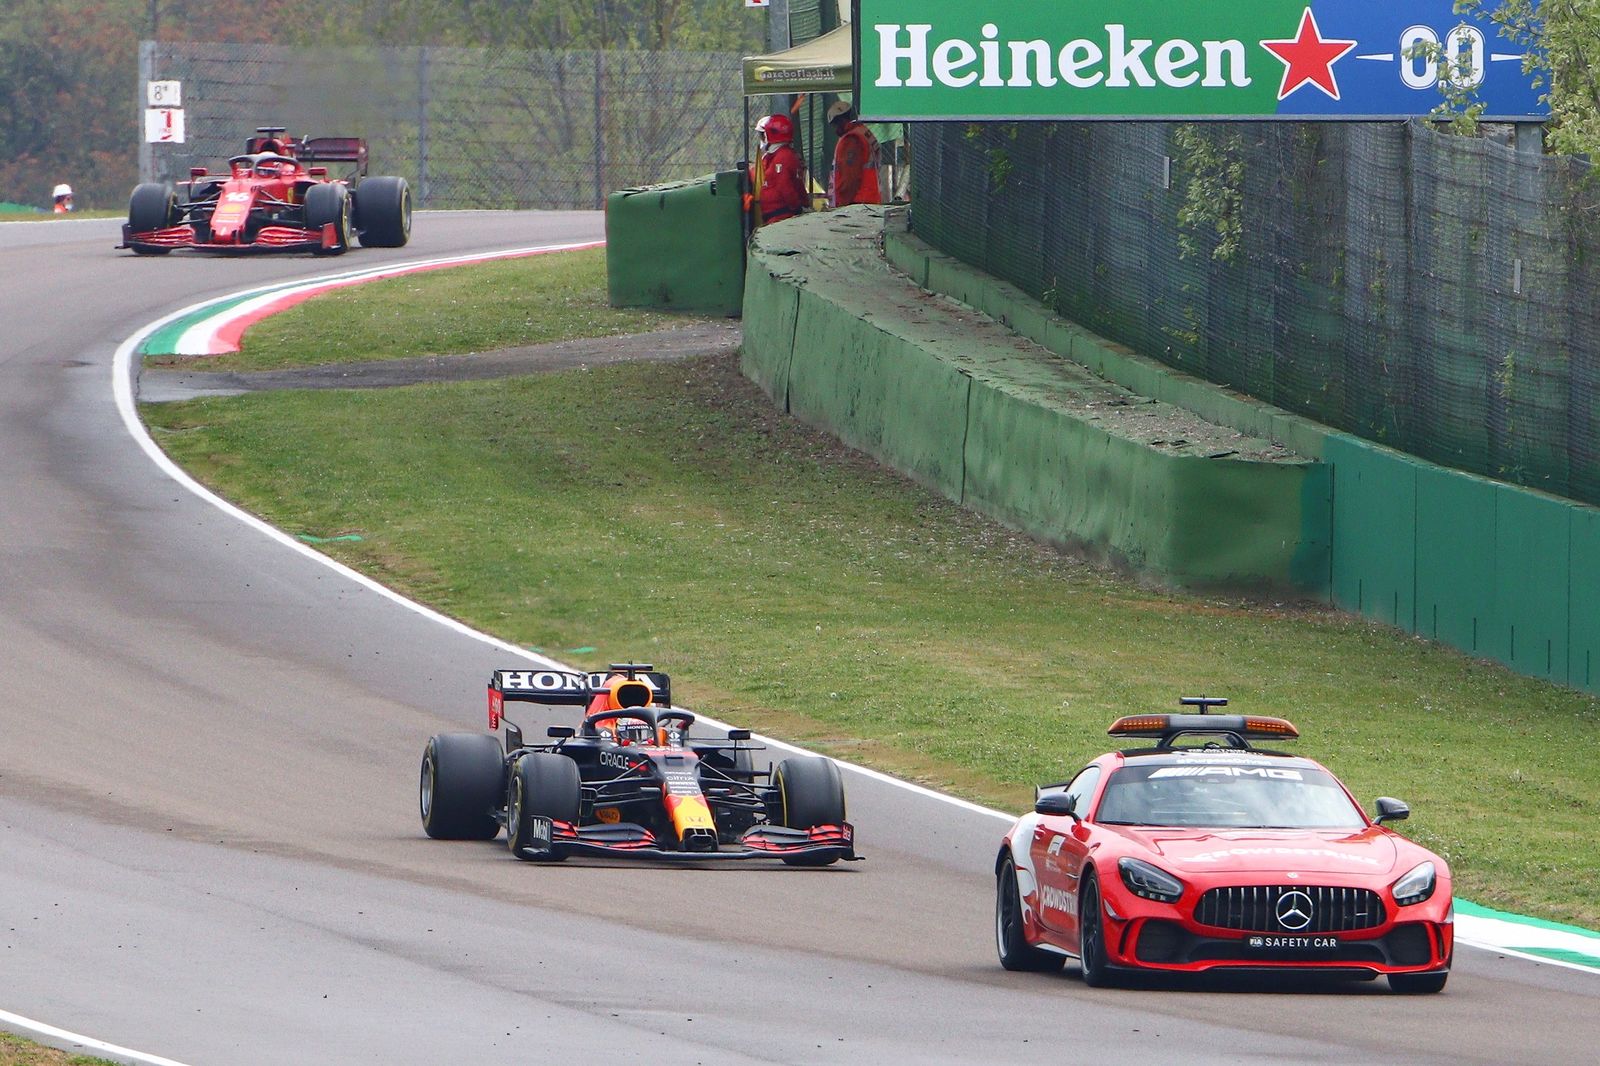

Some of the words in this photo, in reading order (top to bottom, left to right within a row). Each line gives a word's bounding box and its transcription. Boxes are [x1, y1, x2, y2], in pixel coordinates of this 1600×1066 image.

[874, 23, 1252, 87] Heineken
[225, 192, 250, 202] 16
[600, 751, 629, 770] ORACLE
[1197, 766, 1303, 781] AMG
[1265, 938, 1309, 947] SAFETY
[1314, 938, 1337, 947] CAR
